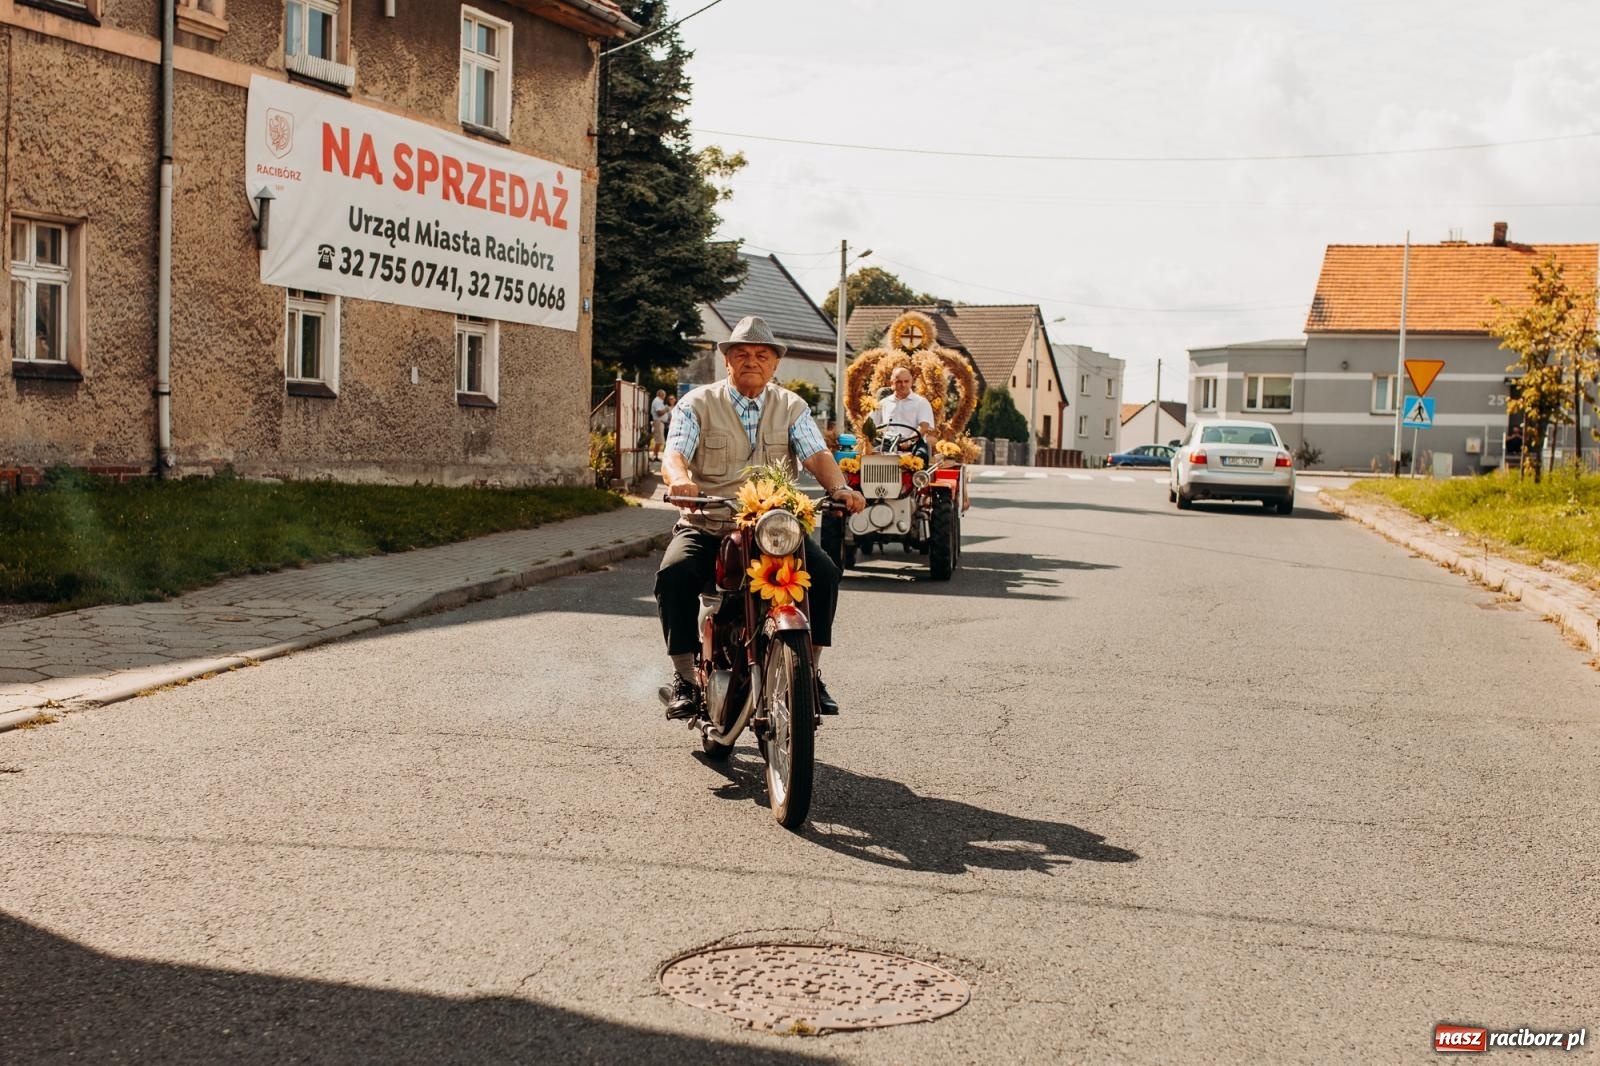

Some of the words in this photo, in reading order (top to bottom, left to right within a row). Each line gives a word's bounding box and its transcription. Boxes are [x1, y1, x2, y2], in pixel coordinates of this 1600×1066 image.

[256, 163, 301, 181] RACIBÓRZ
[321, 122, 384, 185] NA
[393, 143, 569, 230] SPRZEDAŻ
[348, 205, 410, 249] Urząd
[414, 219, 481, 257] Miasta
[485, 235, 554, 272] Racibórz
[338, 246, 365, 278] 32
[368, 251, 407, 285] 755
[411, 260, 463, 301] 0741,
[467, 270, 490, 299] 32
[494, 274, 524, 304] 755
[527, 281, 566, 312] 0668
